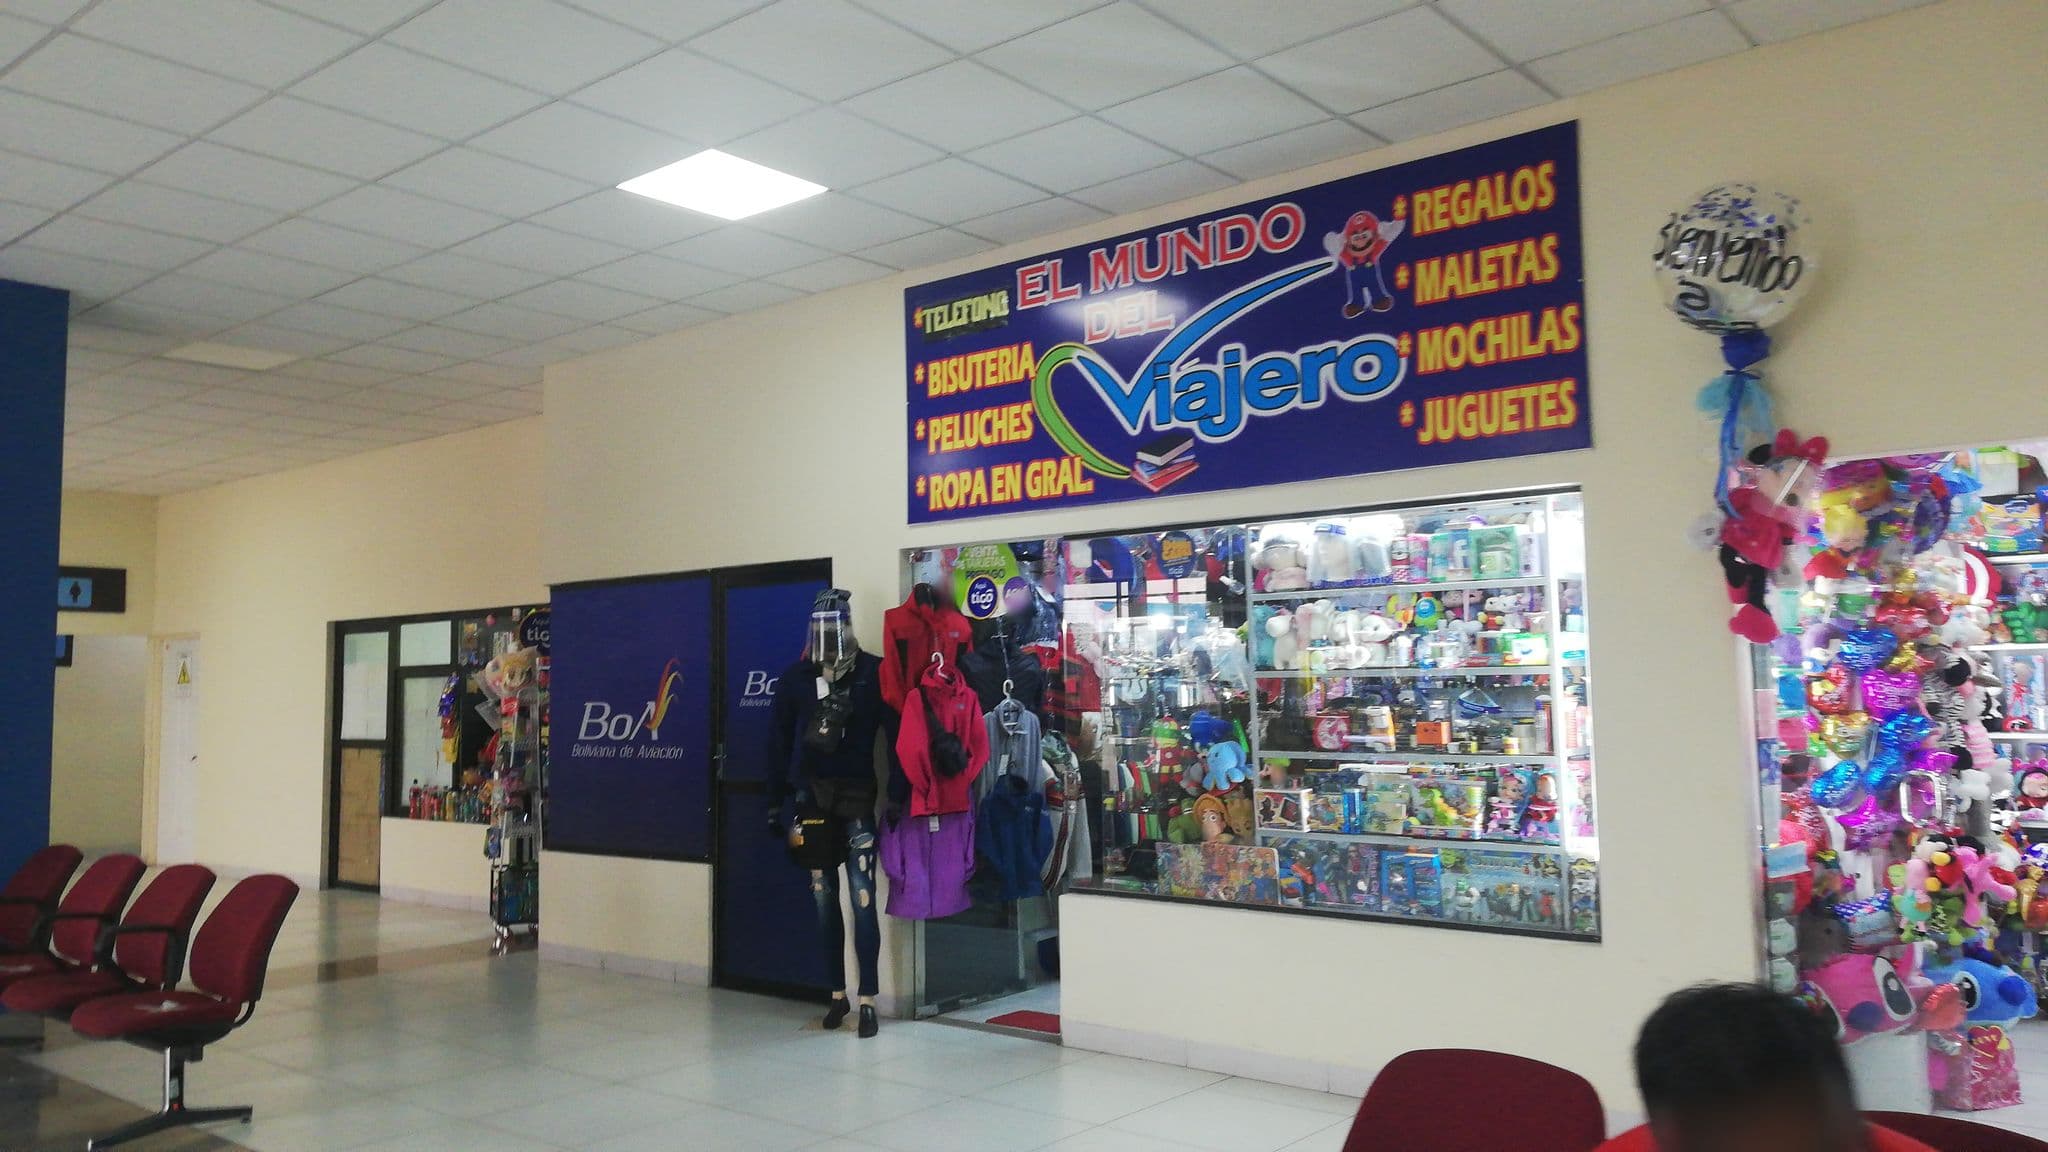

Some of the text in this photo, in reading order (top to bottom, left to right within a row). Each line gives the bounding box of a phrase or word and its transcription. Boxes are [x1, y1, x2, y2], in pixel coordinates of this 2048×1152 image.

[1413, 160, 1556, 236] REGALOS
[1016, 201, 1306, 311] EL MUNDO
[1415, 233, 1559, 305] MALETAS
[1083, 289, 1176, 345] DEL
[1416, 303, 1581, 375] MOCHILAS
[927, 341, 1037, 398] BISUTERIA
[1075, 285, 1405, 440] Viajero
[927, 402, 1036, 454] PELUCHES
[1417, 378, 1578, 445] JUGUETES
[928, 466, 989, 511] ROPA
[990, 461, 1022, 504] EN
[970, 588, 995, 610] tigo
[527, 627, 550, 648] tig
[578, 701, 660, 741] BoA
[571, 743, 684, 760] Boliviana de Aviación
